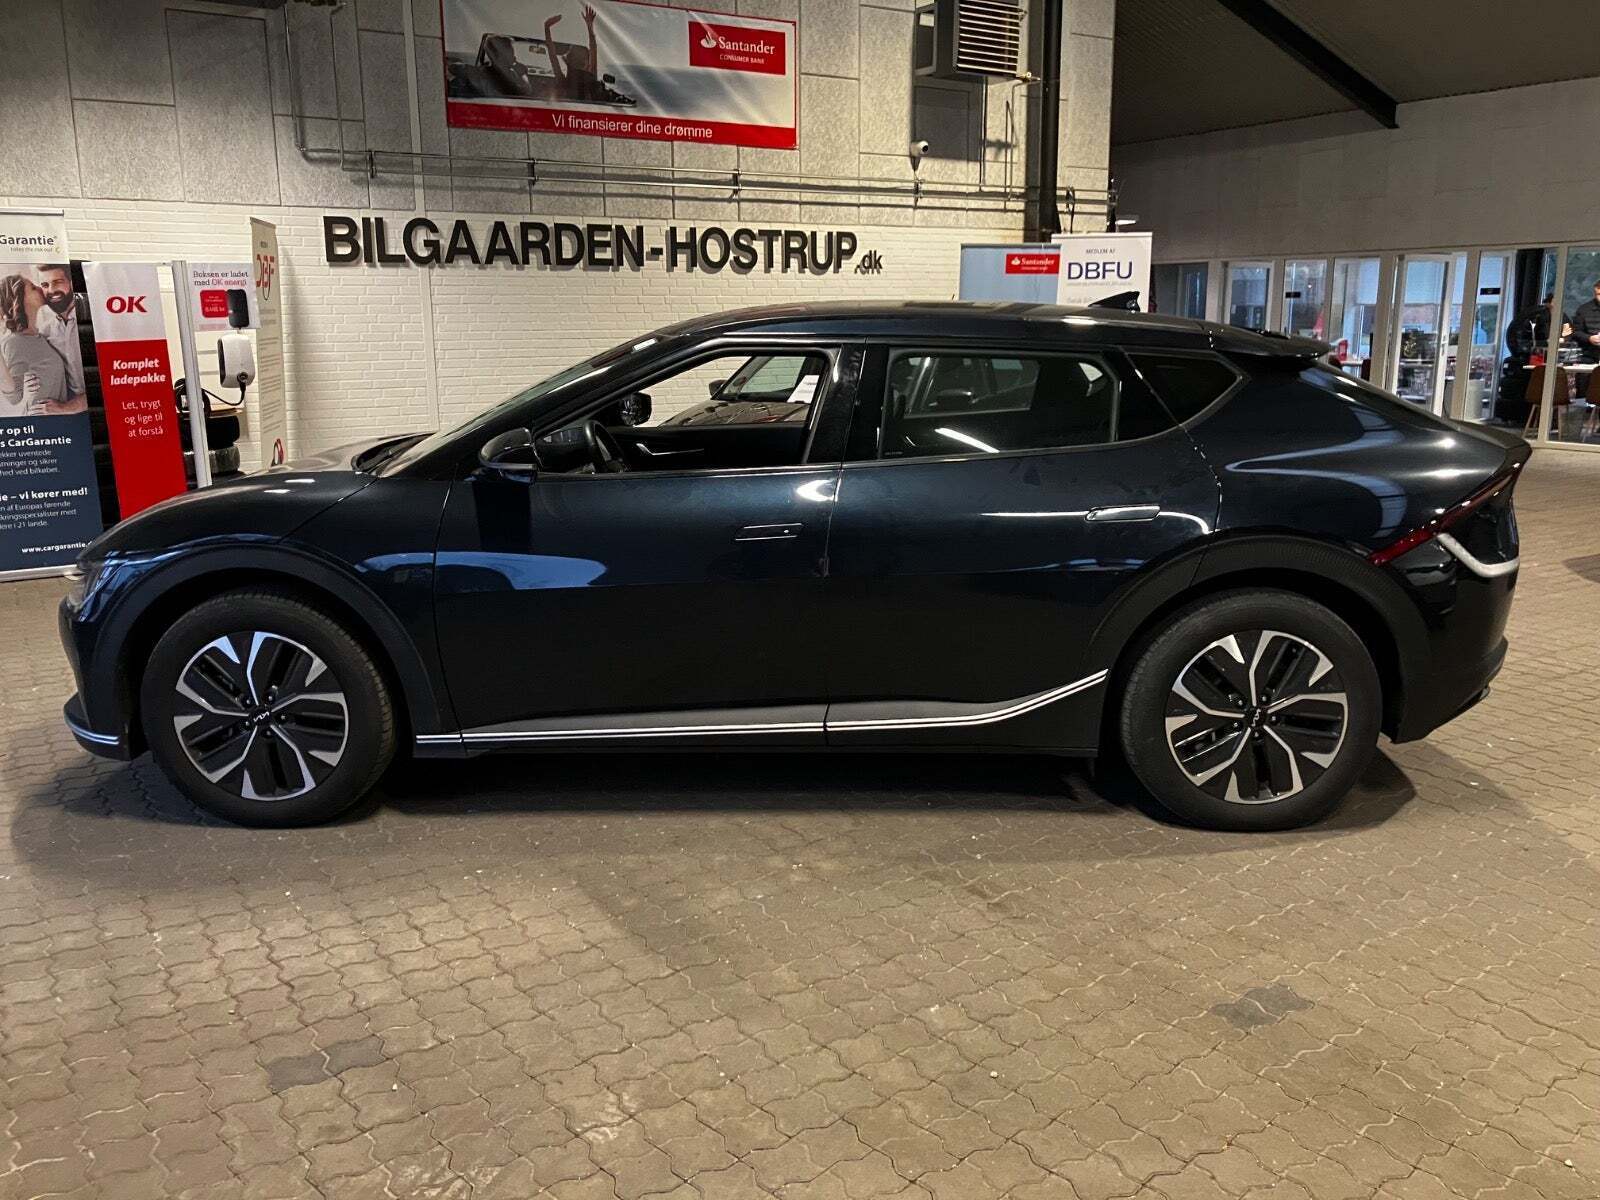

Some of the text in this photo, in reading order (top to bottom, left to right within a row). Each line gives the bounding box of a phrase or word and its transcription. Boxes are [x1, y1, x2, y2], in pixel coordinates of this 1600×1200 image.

[719, 36, 775, 54] Santander
[720, 54, 764, 65] CONSUMER BANK
[552, 113, 713, 138] Vi finansierer dine drømme
[1021, 257, 1055, 267] Santander
[1067, 261, 1133, 280] DBFU
[106, 295, 148, 314] OK
[113, 358, 160, 372] Komplet
[110, 373, 166, 386] ladepakke
[122, 400, 161, 411] Let, trygt
[124, 412, 163, 425] og lige til
[6, 427, 21, 437] op
[23, 425, 35, 435] til
[128, 425, 164, 438] at forstå
[8, 435, 73, 447] CarGarantie
[19, 490, 29, 500] vi
[31, 490, 60, 499] kører
[62, 487, 88, 497] med!
